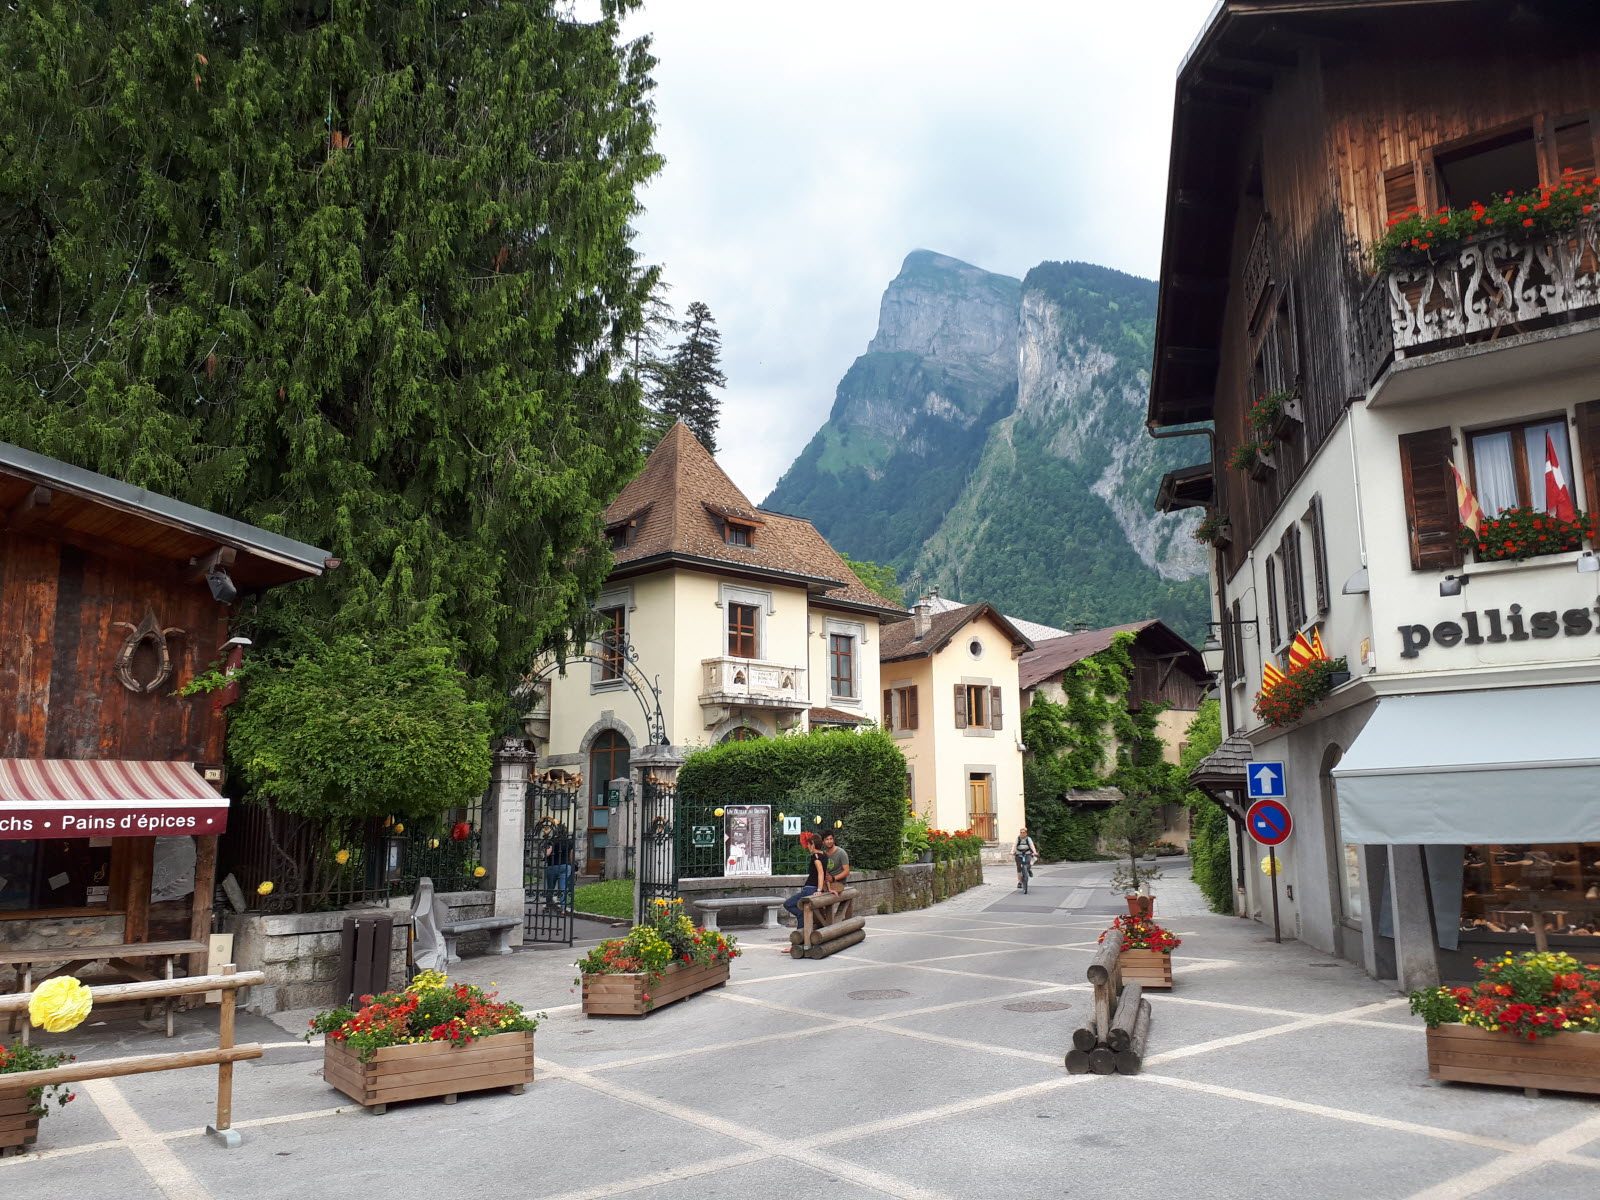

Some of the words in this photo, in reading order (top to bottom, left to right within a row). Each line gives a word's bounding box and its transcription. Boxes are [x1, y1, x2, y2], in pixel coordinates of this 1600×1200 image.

[0, 817, 33, 831] chs
[62, 815, 115, 830] Pains
[120, 813, 196, 831] d'épices
